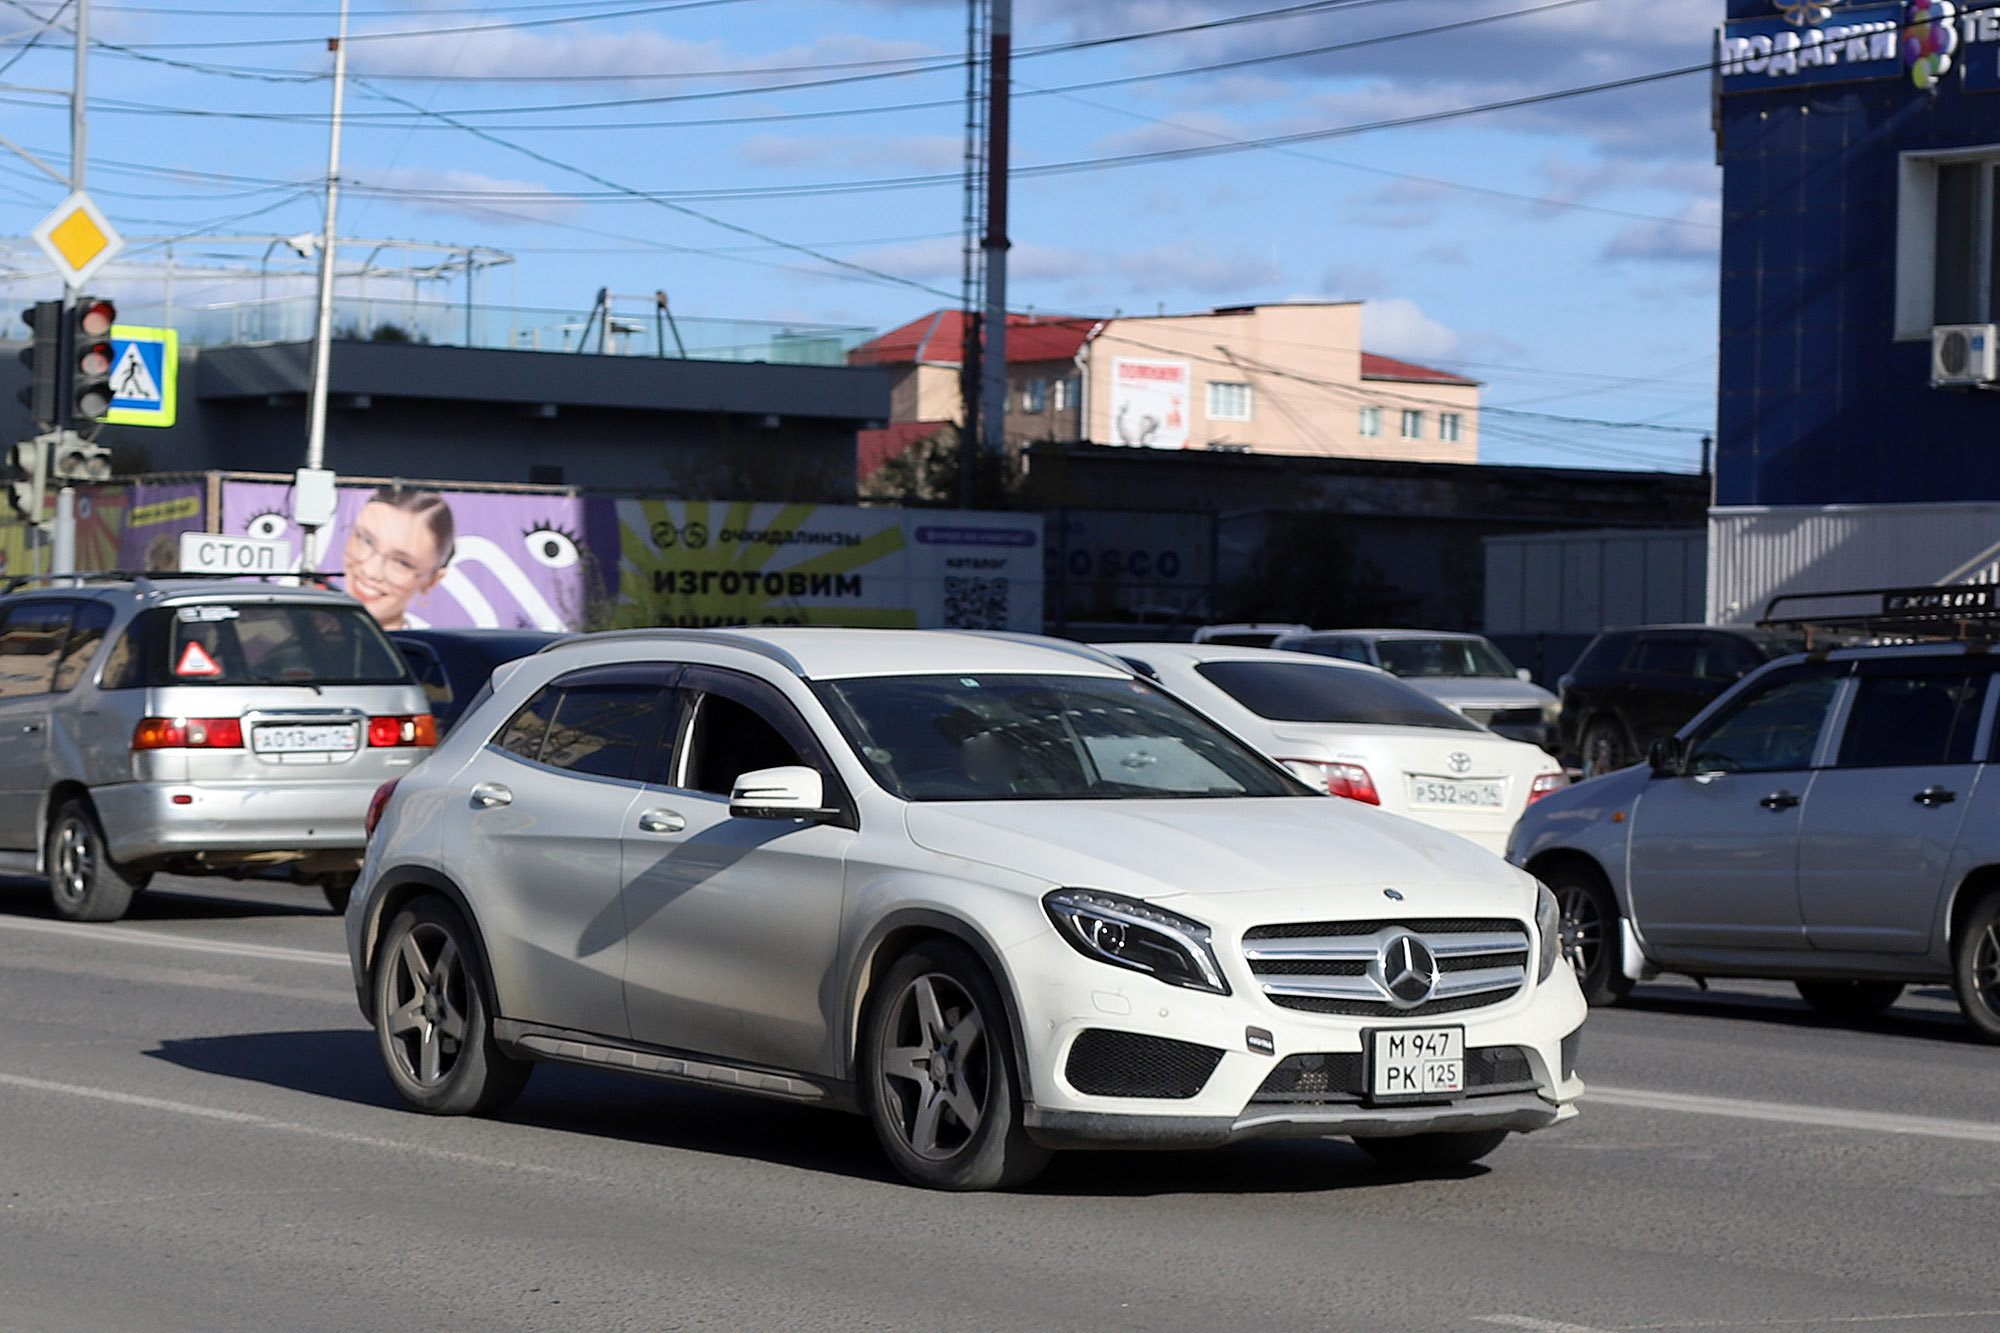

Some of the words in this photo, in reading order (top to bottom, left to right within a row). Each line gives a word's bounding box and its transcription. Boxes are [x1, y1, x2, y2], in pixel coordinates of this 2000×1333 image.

[1719, 20, 1897, 77] ПОДАРКИ
[200, 541, 274, 569] СТОП
[1387, 1066, 1416, 1090] РК
[1427, 1063, 1456, 1083] 125
